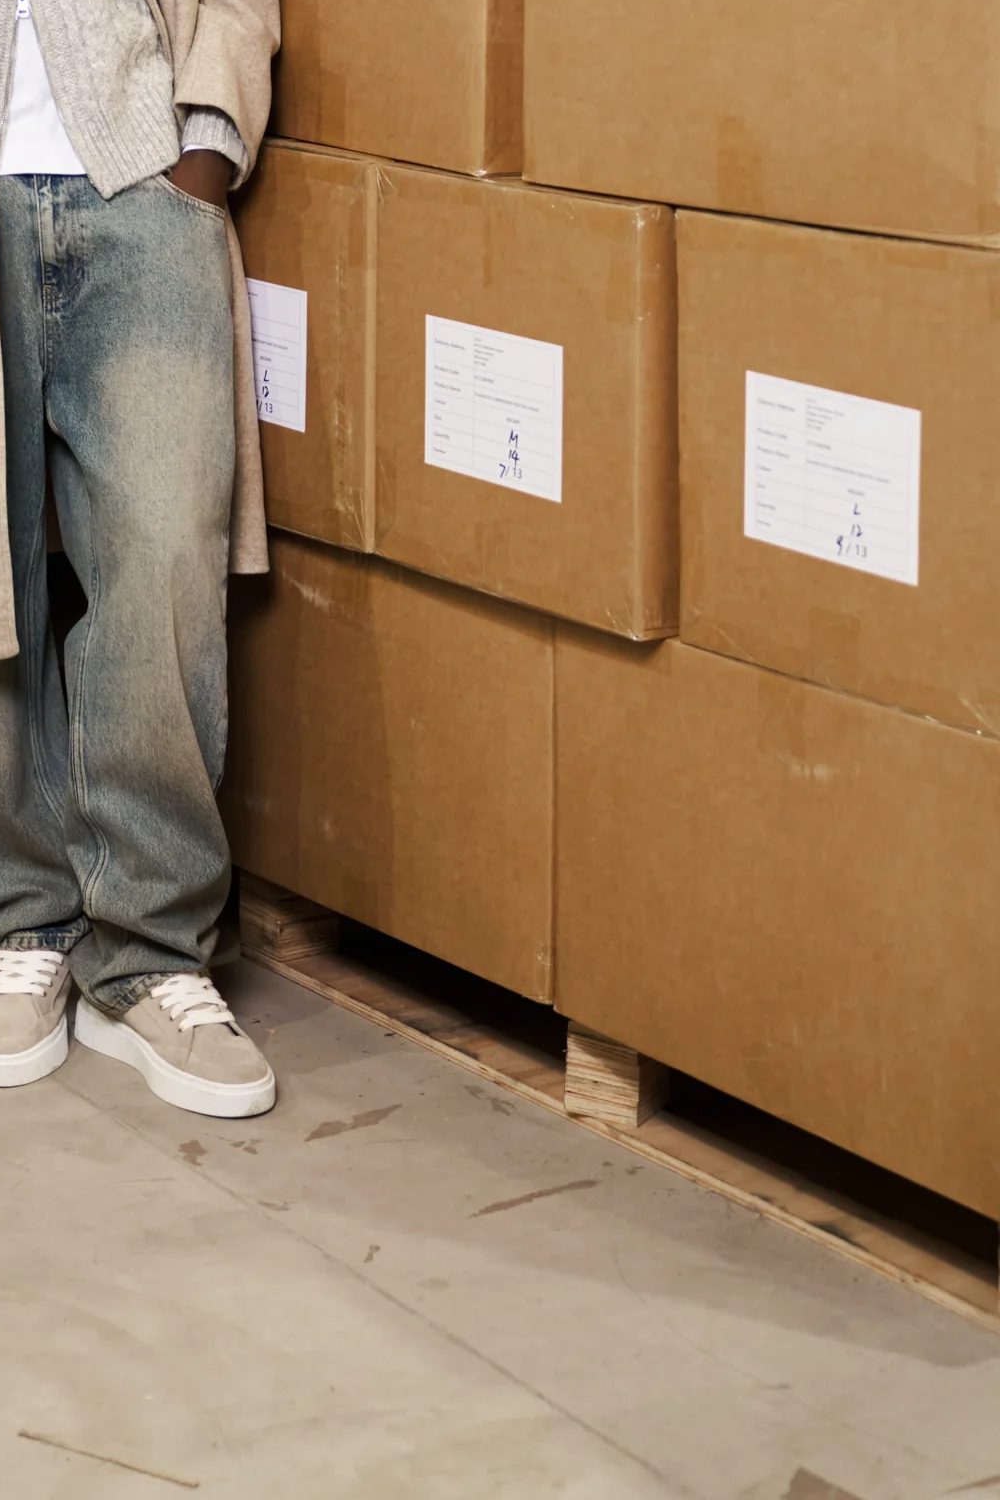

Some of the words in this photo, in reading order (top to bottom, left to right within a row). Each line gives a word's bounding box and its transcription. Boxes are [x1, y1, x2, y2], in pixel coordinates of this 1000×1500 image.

[263, 370, 269, 382] L
[508, 430, 518, 448] M
[509, 449, 520, 465] 14
[853, 503, 861, 515] L
